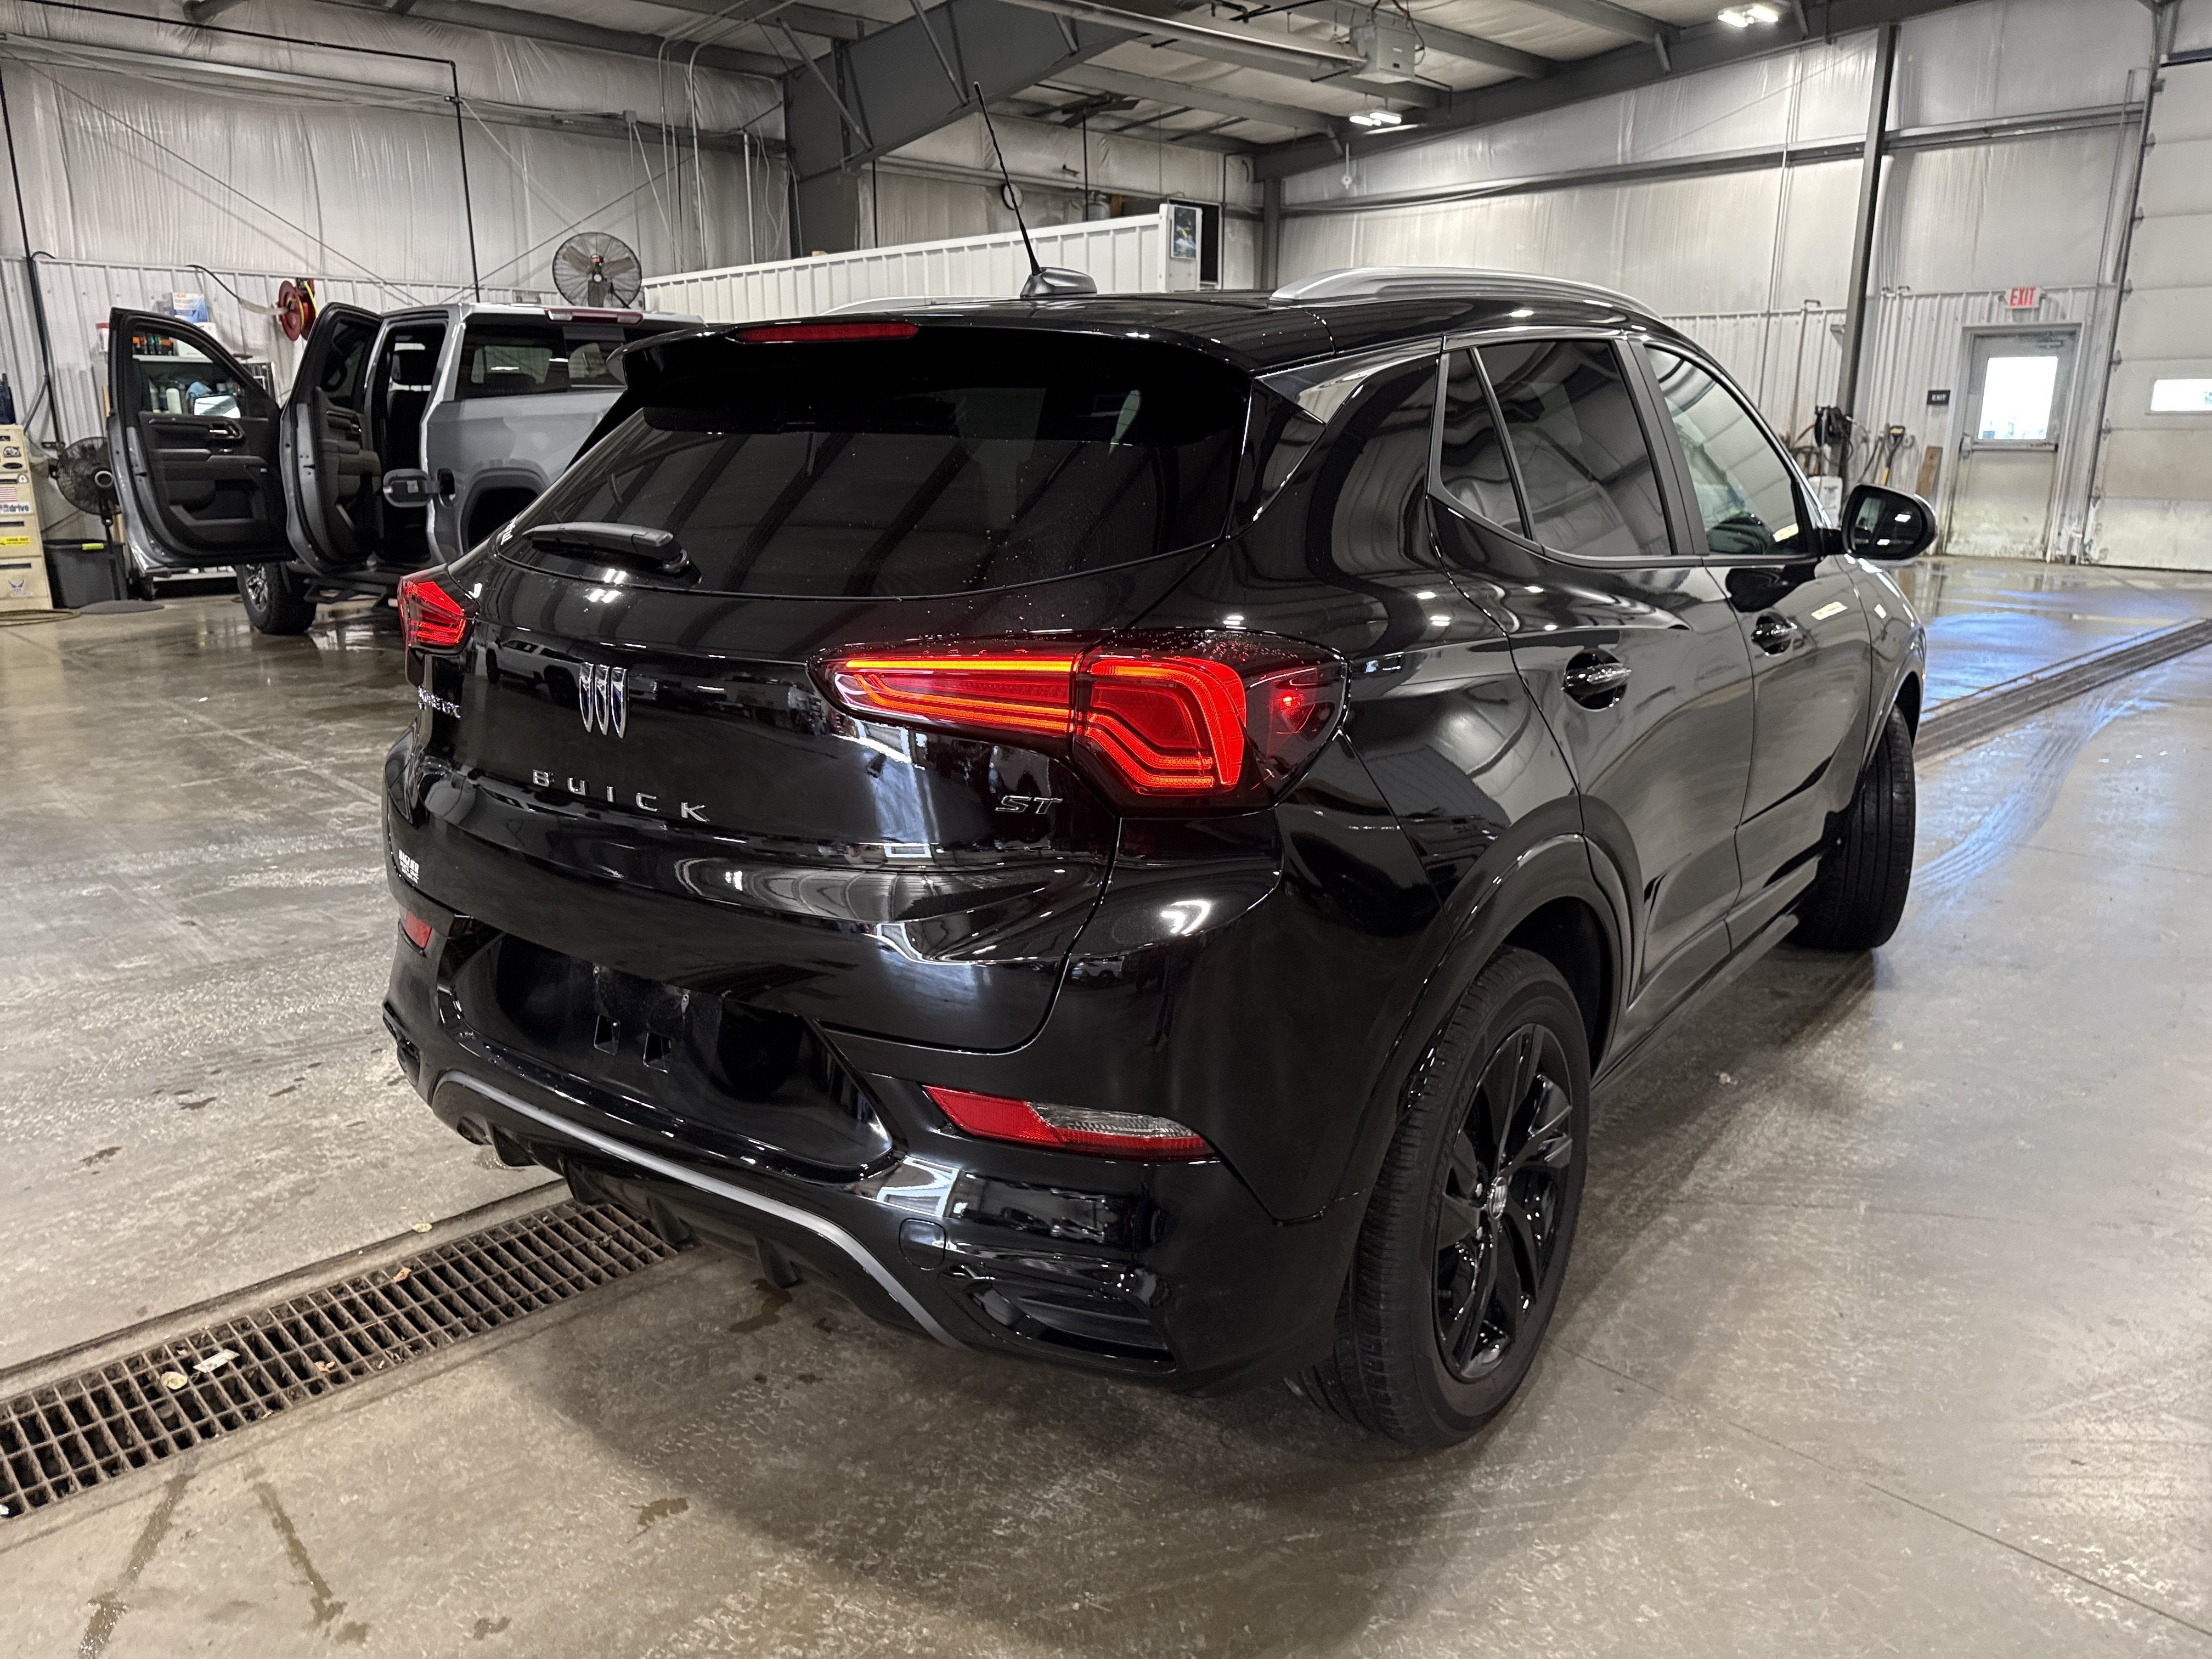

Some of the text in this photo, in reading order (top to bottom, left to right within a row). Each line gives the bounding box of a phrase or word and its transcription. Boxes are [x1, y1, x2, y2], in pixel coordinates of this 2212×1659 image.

[2010, 287, 2036, 307] EXIT
[1931, 393, 1947, 402] EXIT
[533, 769, 709, 822] BUICK
[995, 795, 1063, 814] ST
